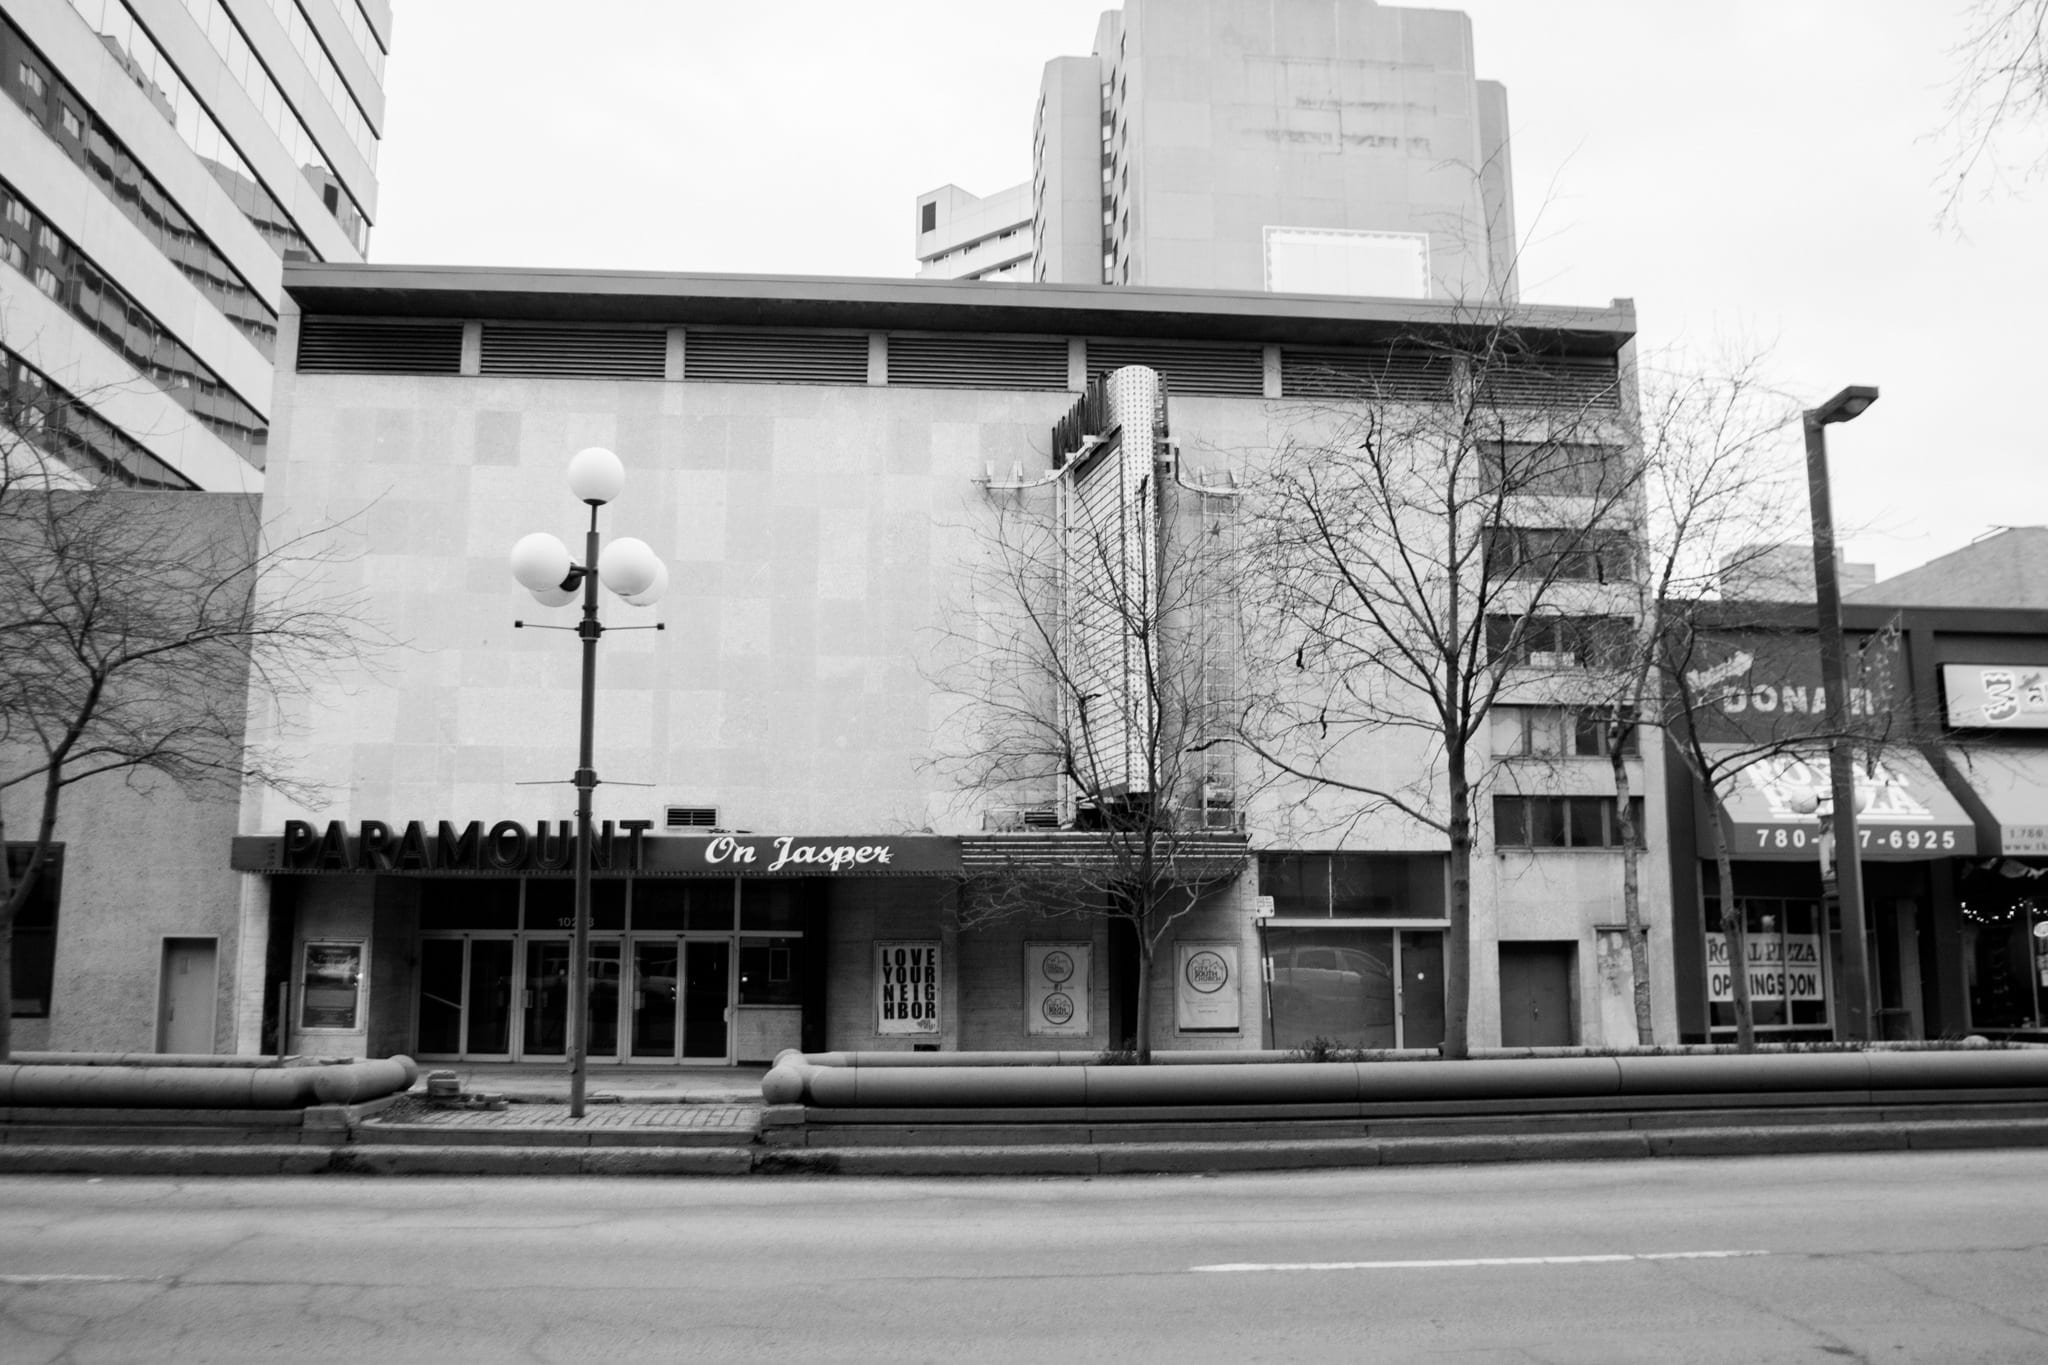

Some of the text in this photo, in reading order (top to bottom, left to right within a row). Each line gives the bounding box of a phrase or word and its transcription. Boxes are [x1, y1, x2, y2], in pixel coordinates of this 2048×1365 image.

[1722, 684, 1874, 715] DONAR
[283, 818, 653, 871] PARAMOUNT
[1757, 828, 1956, 849] 780-7-6925
[704, 835, 895, 872] On Jasper
[558, 916, 595, 928] 1023
[883, 948, 935, 966] LOVE
[1709, 942, 1761, 963] ROL
[883, 966, 935, 984] YOUR
[1713, 974, 1776, 996] OPING
[883, 984, 935, 1002] NEIG
[884, 1001, 936, 1020] HBOR
